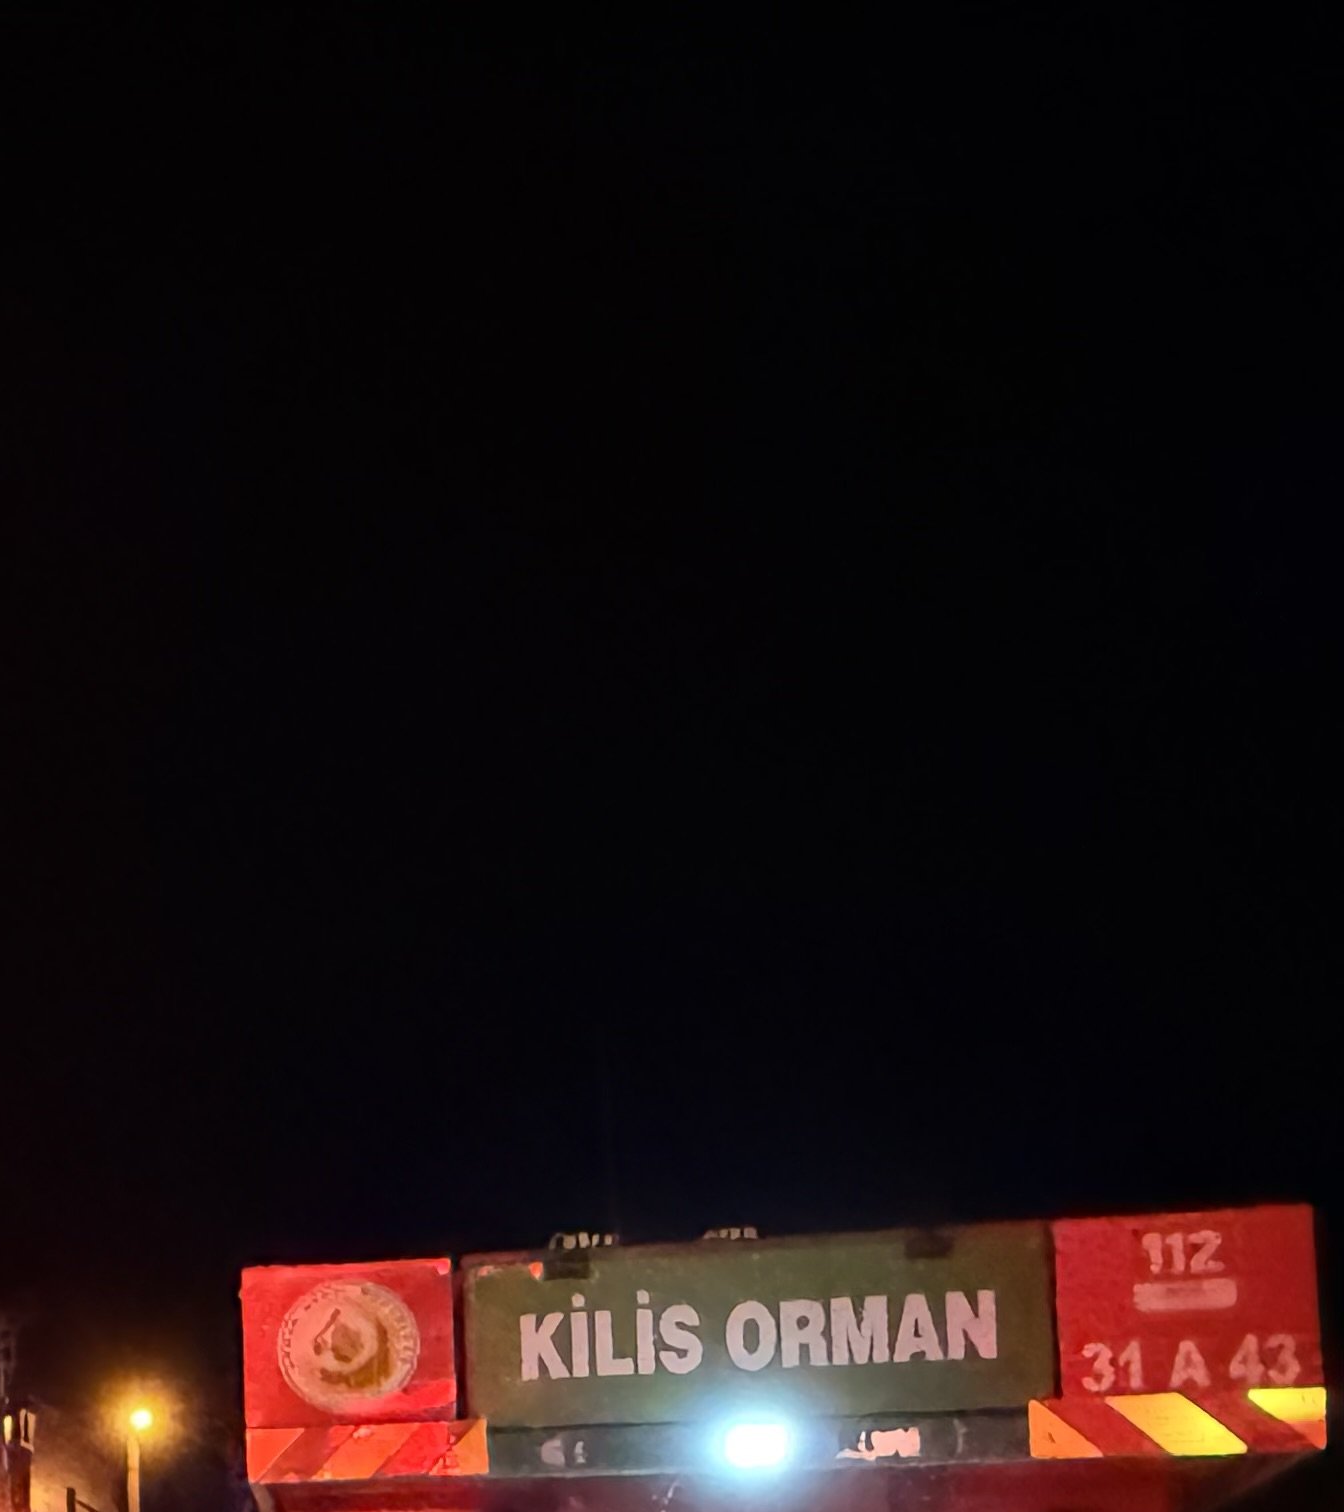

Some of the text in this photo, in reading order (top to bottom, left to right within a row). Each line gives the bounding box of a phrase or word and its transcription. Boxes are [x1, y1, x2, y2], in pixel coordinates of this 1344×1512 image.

[1141, 1229, 1226, 1275] 112
[519, 1288, 704, 1381] KİLİS
[725, 1288, 999, 1372] ORMAN
[1081, 1332, 1301, 1392] 31 A 43
